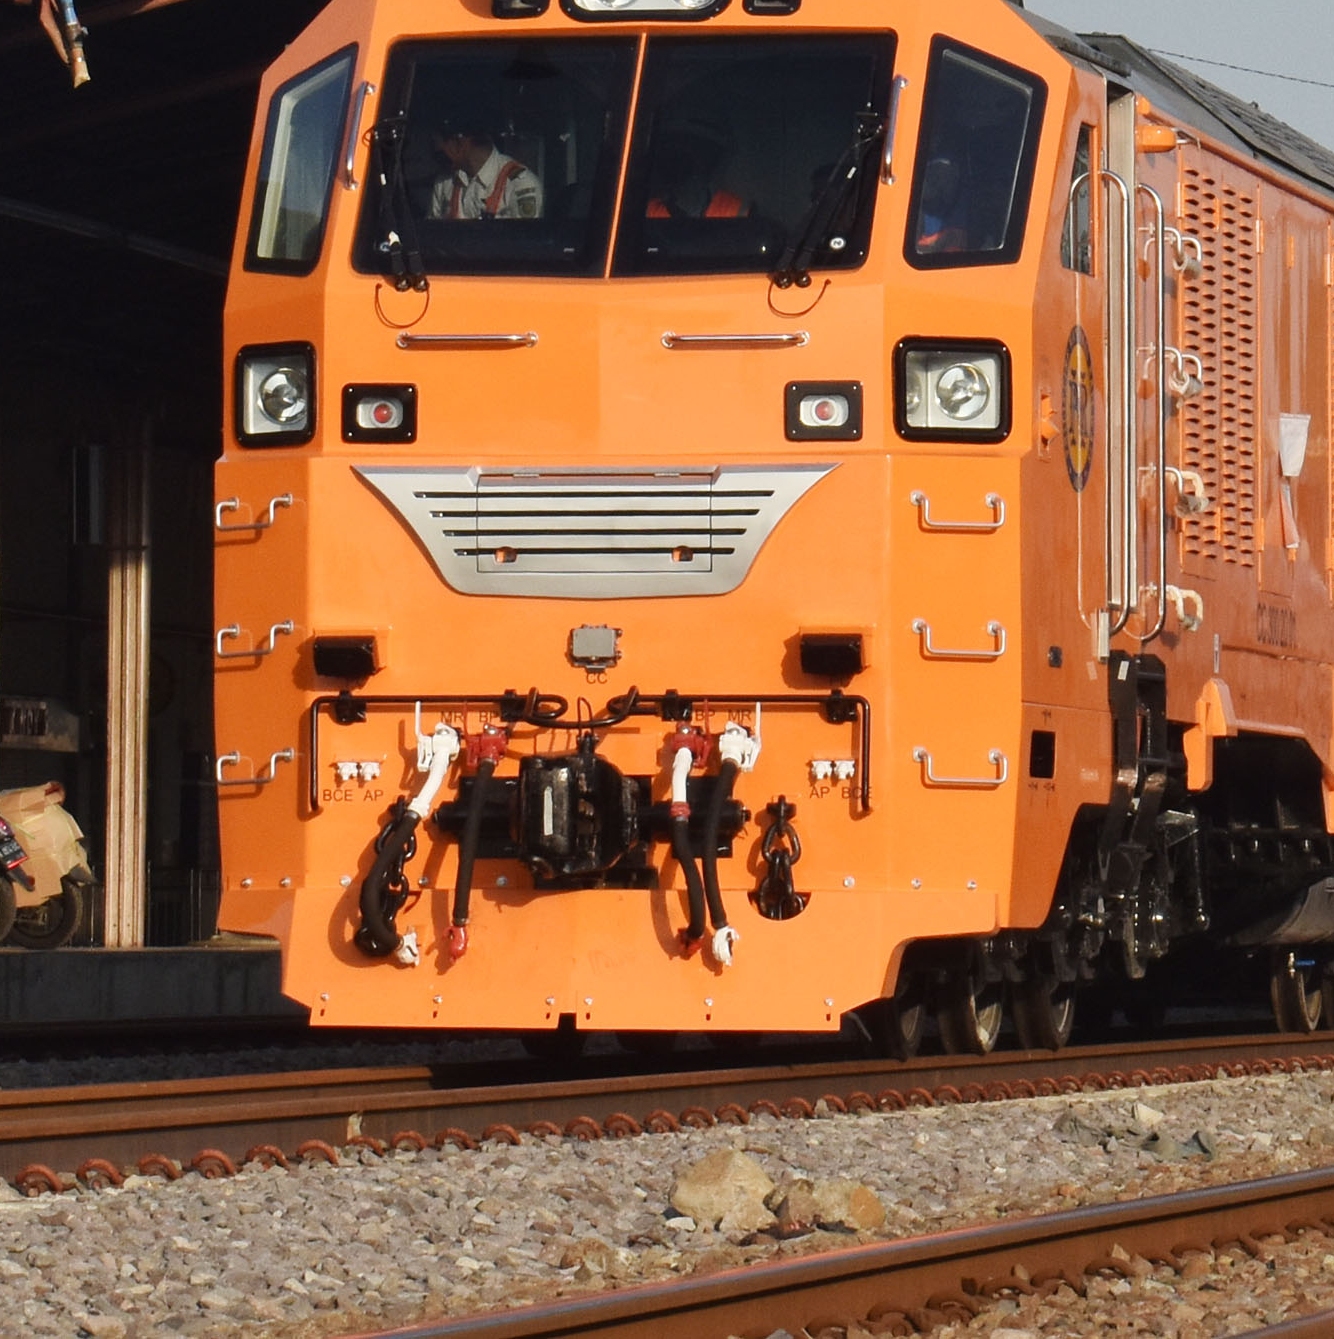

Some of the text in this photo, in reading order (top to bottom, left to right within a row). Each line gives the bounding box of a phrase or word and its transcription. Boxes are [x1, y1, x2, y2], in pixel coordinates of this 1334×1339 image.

[586, 671, 608, 684] CC
[440, 711, 464, 724] MR
[479, 710, 499, 723] BP
[695, 709, 716, 722] BP
[727, 709, 752, 723] MR
[323, 789, 353, 802] BCE
[363, 789, 384, 802] AP
[809, 786, 830, 799] AP
